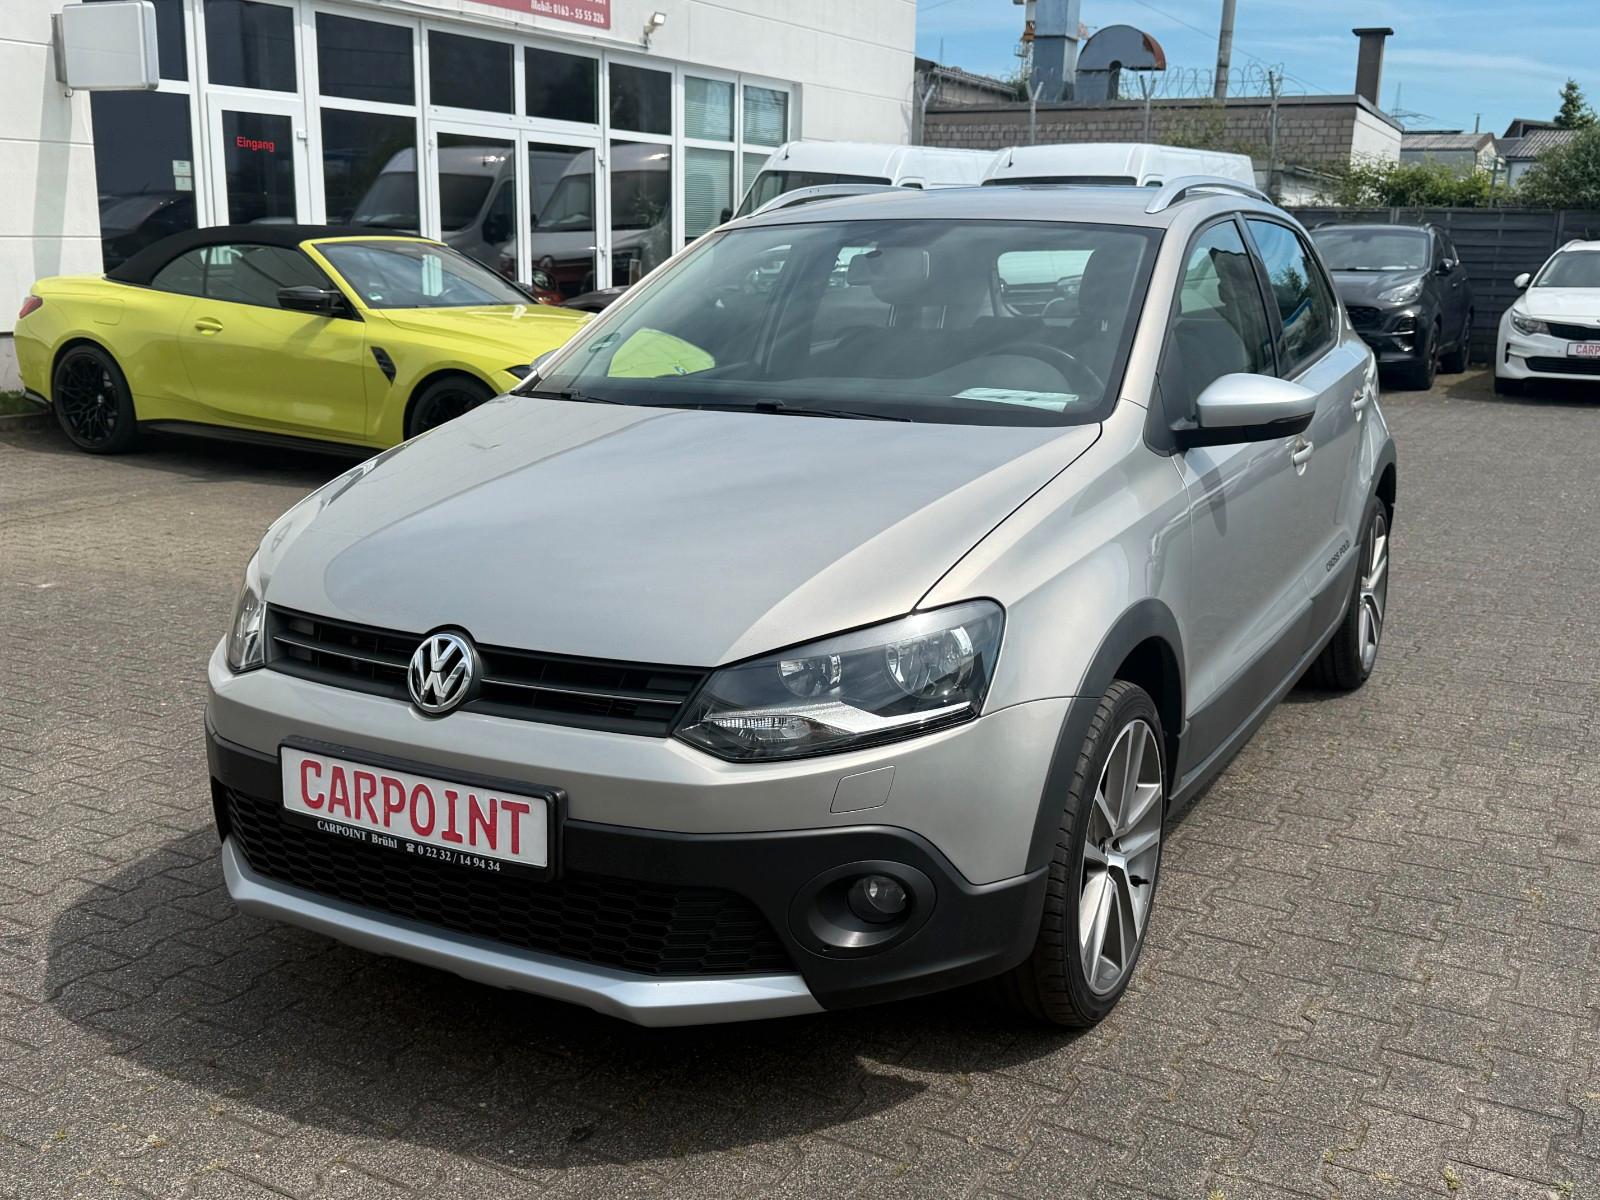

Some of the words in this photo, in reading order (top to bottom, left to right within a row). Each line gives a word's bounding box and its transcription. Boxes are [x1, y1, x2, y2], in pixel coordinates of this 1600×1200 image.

[531, 0, 552, 13] Mobil:
[553, 4, 569, 16] 0163
[575, 8, 583, 20] 55
[584, 9, 592, 22] 55
[236, 136, 275, 153] Eingang
[300, 759, 530, 855] CARPOINT
[317, 820, 367, 840] CARPOINT
[371, 833, 398, 849] Brühl
[425, 846, 438, 858] 22
[439, 850, 451, 861] 32
[459, 854, 472, 866] 14
[473, 857, 486, 869] 94
[487, 860, 501, 872] 34
